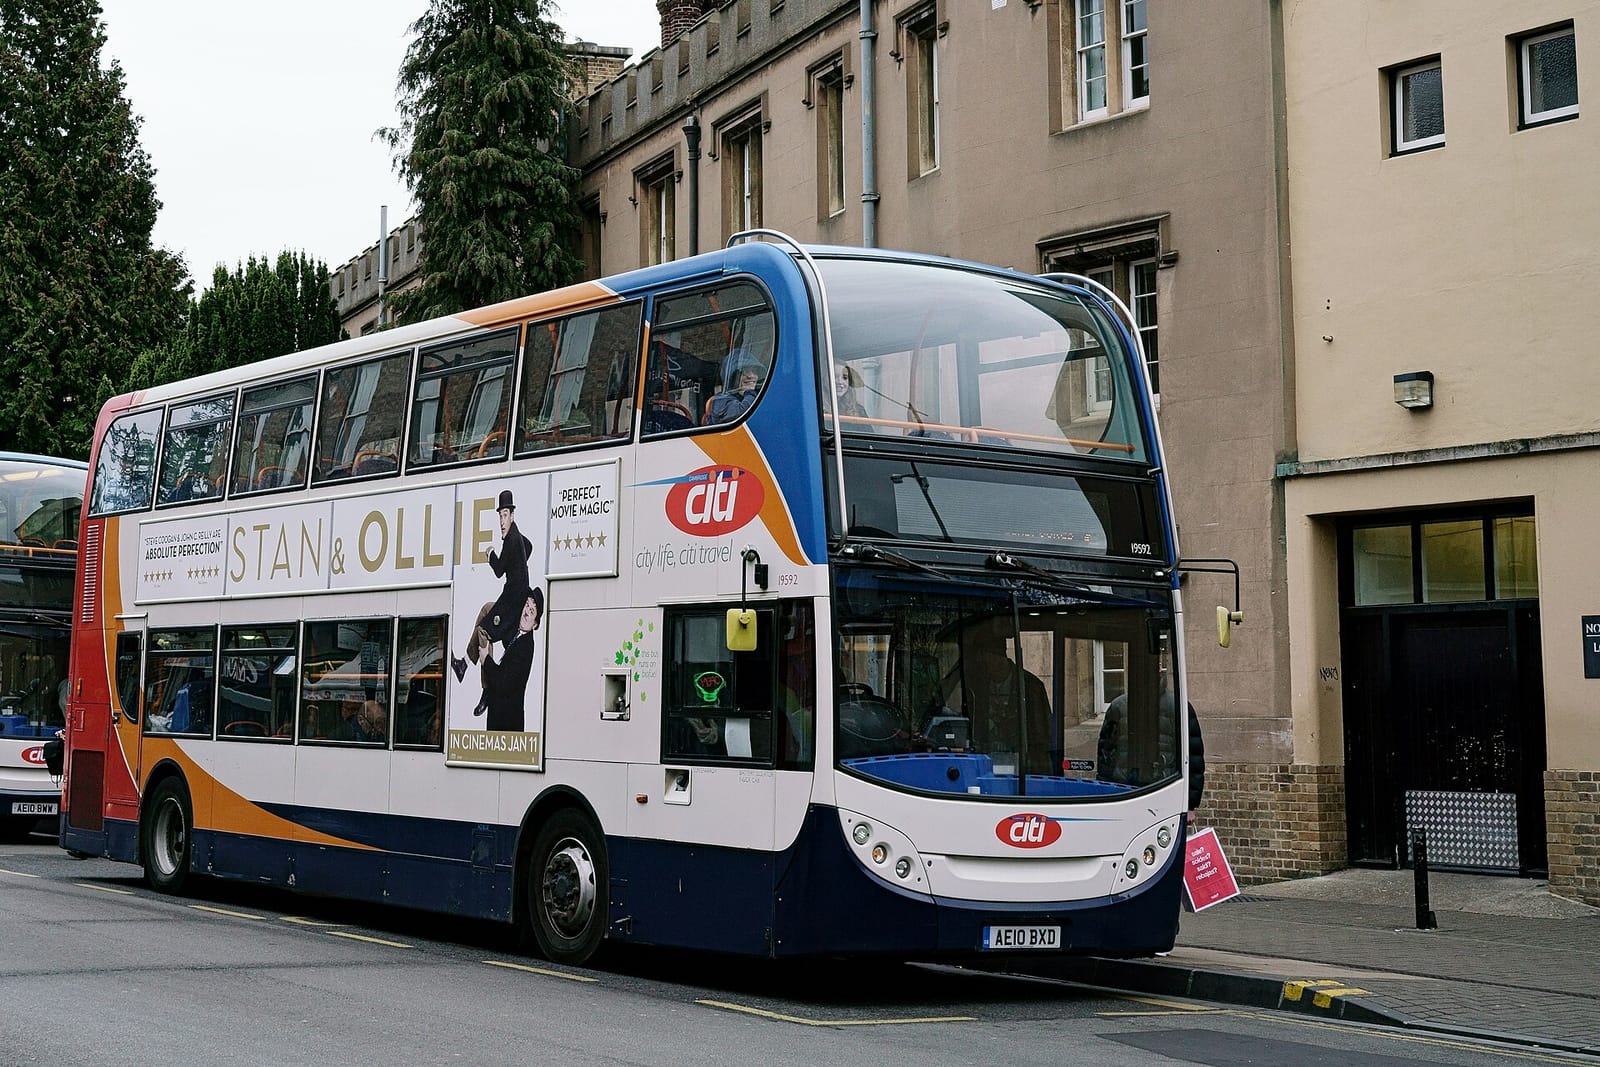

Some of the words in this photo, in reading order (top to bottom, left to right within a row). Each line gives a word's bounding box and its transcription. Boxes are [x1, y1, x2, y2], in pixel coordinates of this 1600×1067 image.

[685, 468, 739, 525] citi
[550, 503, 578, 520] MOVIE
[230, 518, 322, 583] STAN
[331, 537, 346, 576] &
[358, 497, 496, 573] OLLIE
[1131, 542, 1151, 555] 19592
[145, 544, 178, 561] ABSOLUTE
[635, 546, 657, 575] city
[657, 543, 676, 573] life,
[680, 542, 697, 566] citi
[699, 538, 733, 564] travel
[778, 574, 798, 587] 19592
[450, 733, 460, 749] IN
[461, 734, 507, 752] CINEMAS
[508, 735, 527, 753] JAN
[528, 736, 538, 753] 11
[1009, 816, 1046, 842] citi
[995, 929, 1026, 946] AE10
[1029, 928, 1056, 946] BXD
